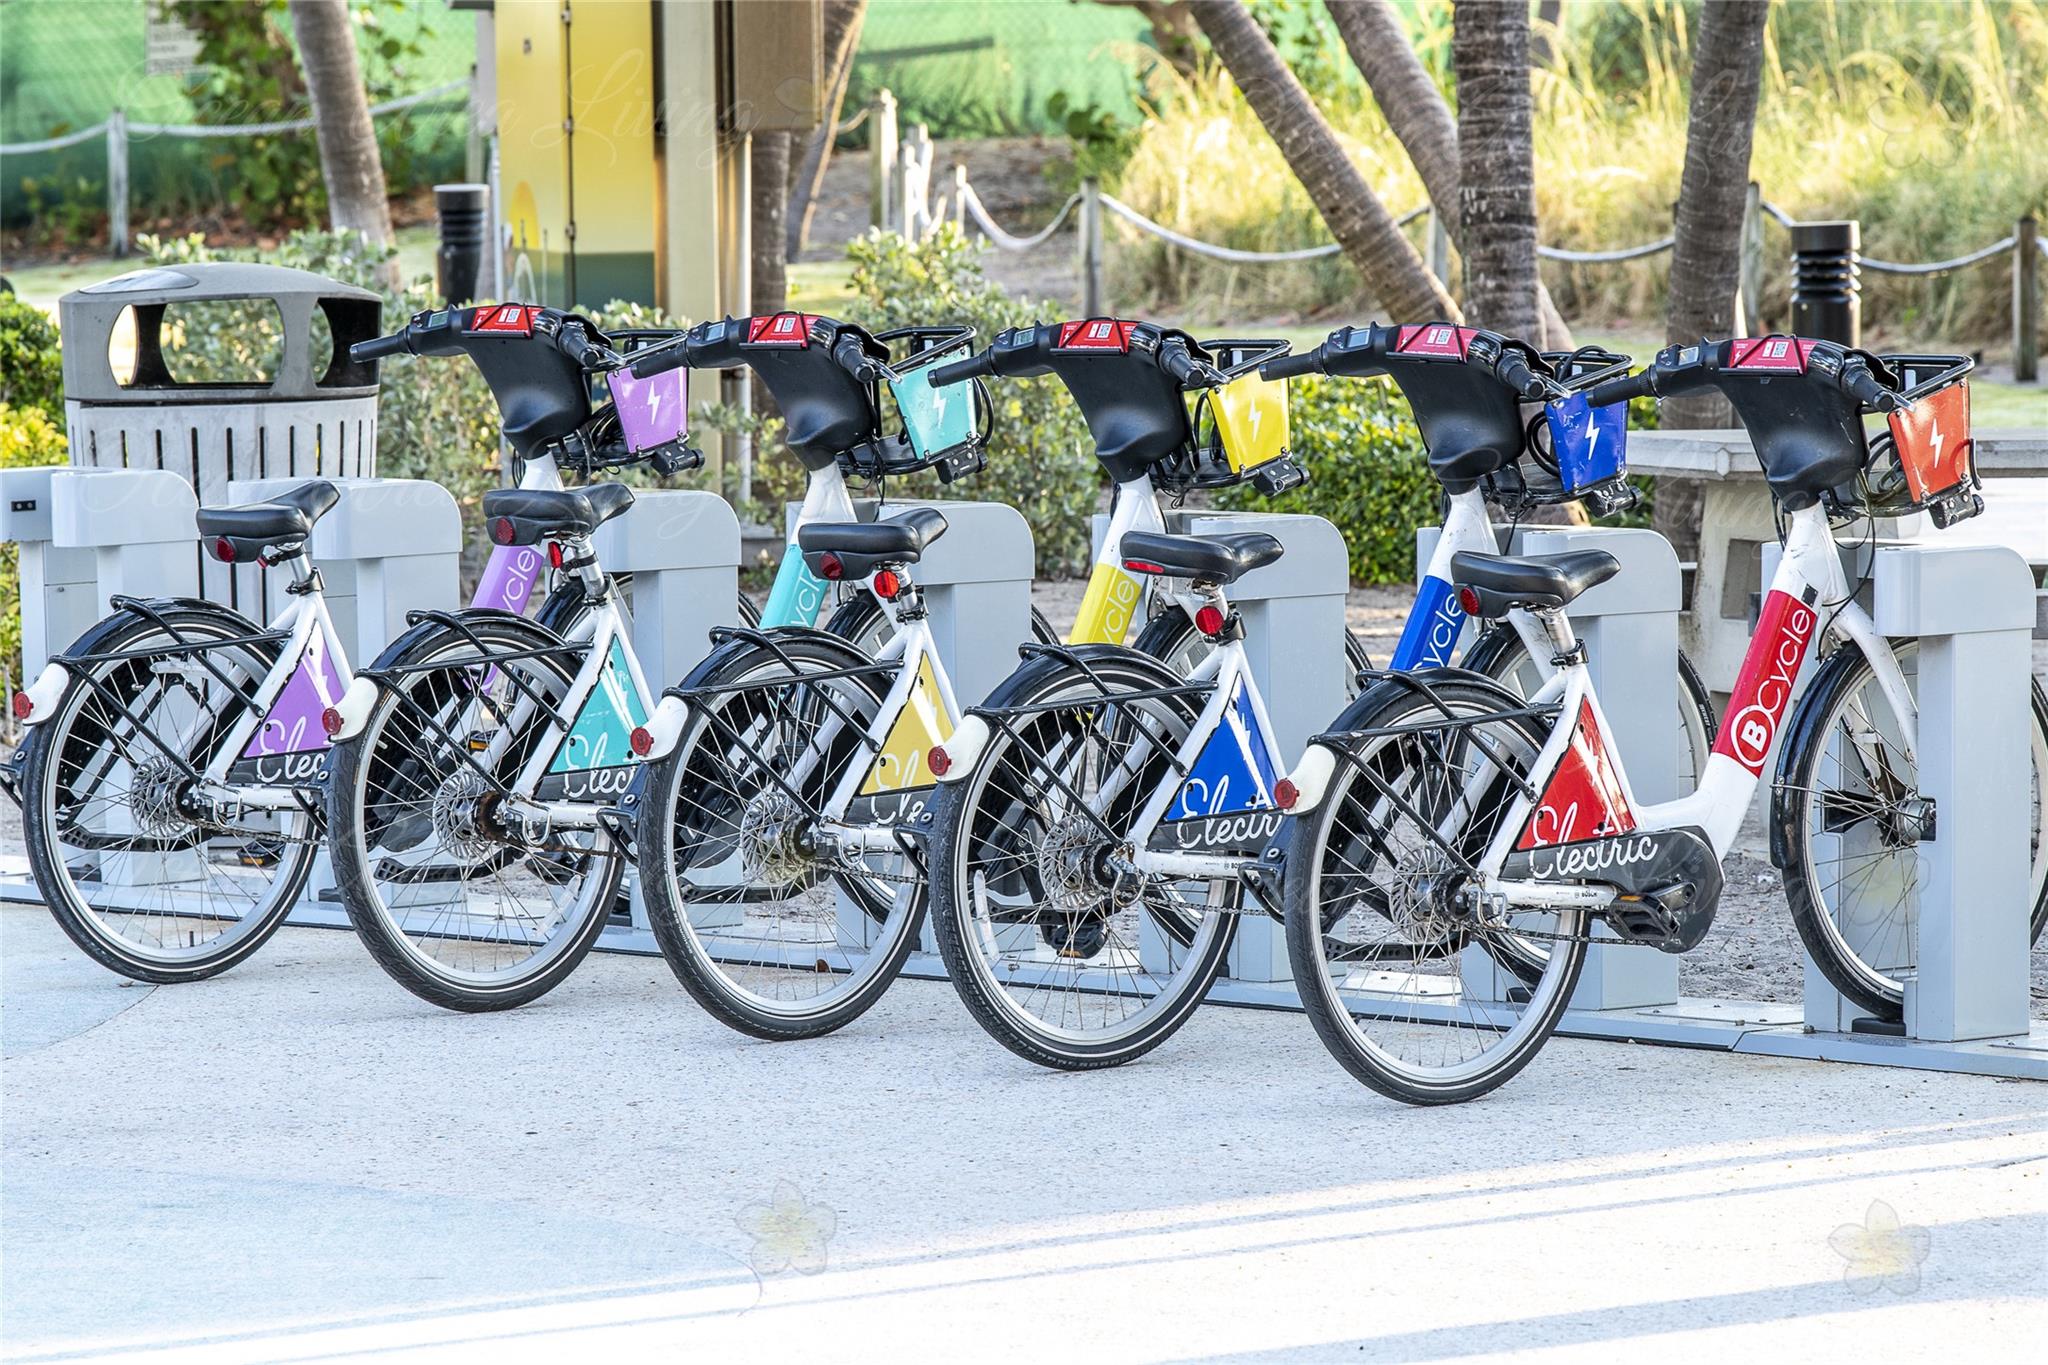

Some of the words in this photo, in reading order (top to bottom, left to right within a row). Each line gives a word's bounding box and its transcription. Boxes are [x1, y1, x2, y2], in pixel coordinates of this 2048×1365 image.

[791, 575, 821, 628] ycl
[1411, 593, 1462, 670] ycle
[256, 715, 336, 783] Elec
[1176, 774, 1283, 849] Electr
[1529, 801, 1658, 879] Electric
